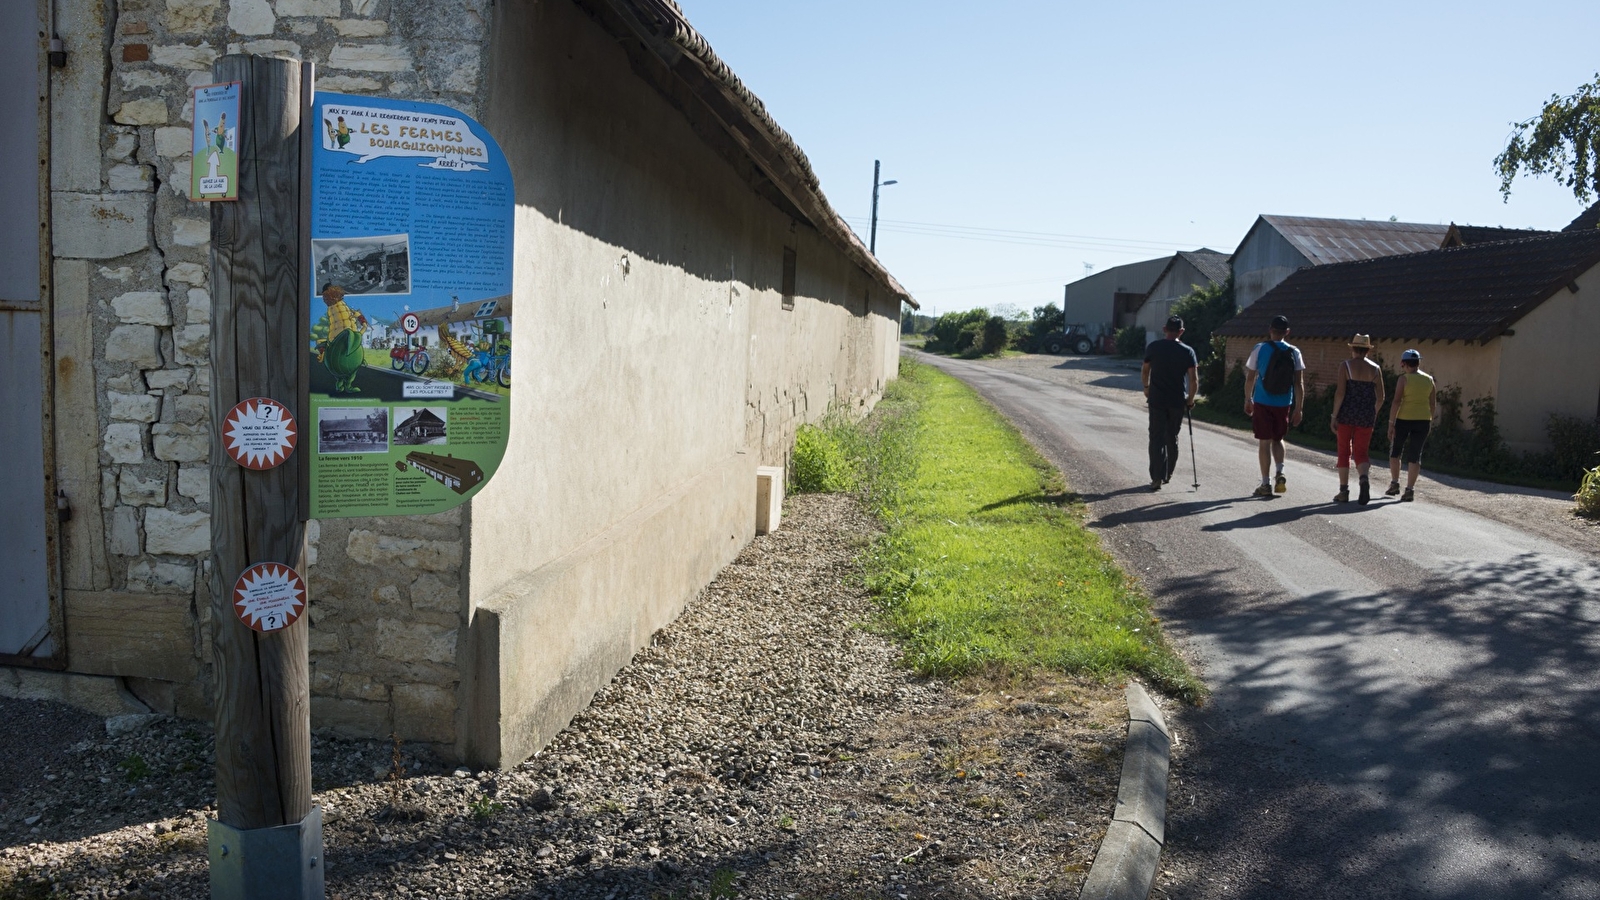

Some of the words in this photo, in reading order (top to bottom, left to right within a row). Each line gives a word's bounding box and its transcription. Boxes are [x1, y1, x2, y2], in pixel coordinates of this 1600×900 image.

[360, 122, 390, 136] LES
[399, 126, 463, 142] FERMES
[369, 138, 482, 156] BOURGUIGNONNES
[264, 406, 272, 418] ?
[268, 617, 275, 628] ?
